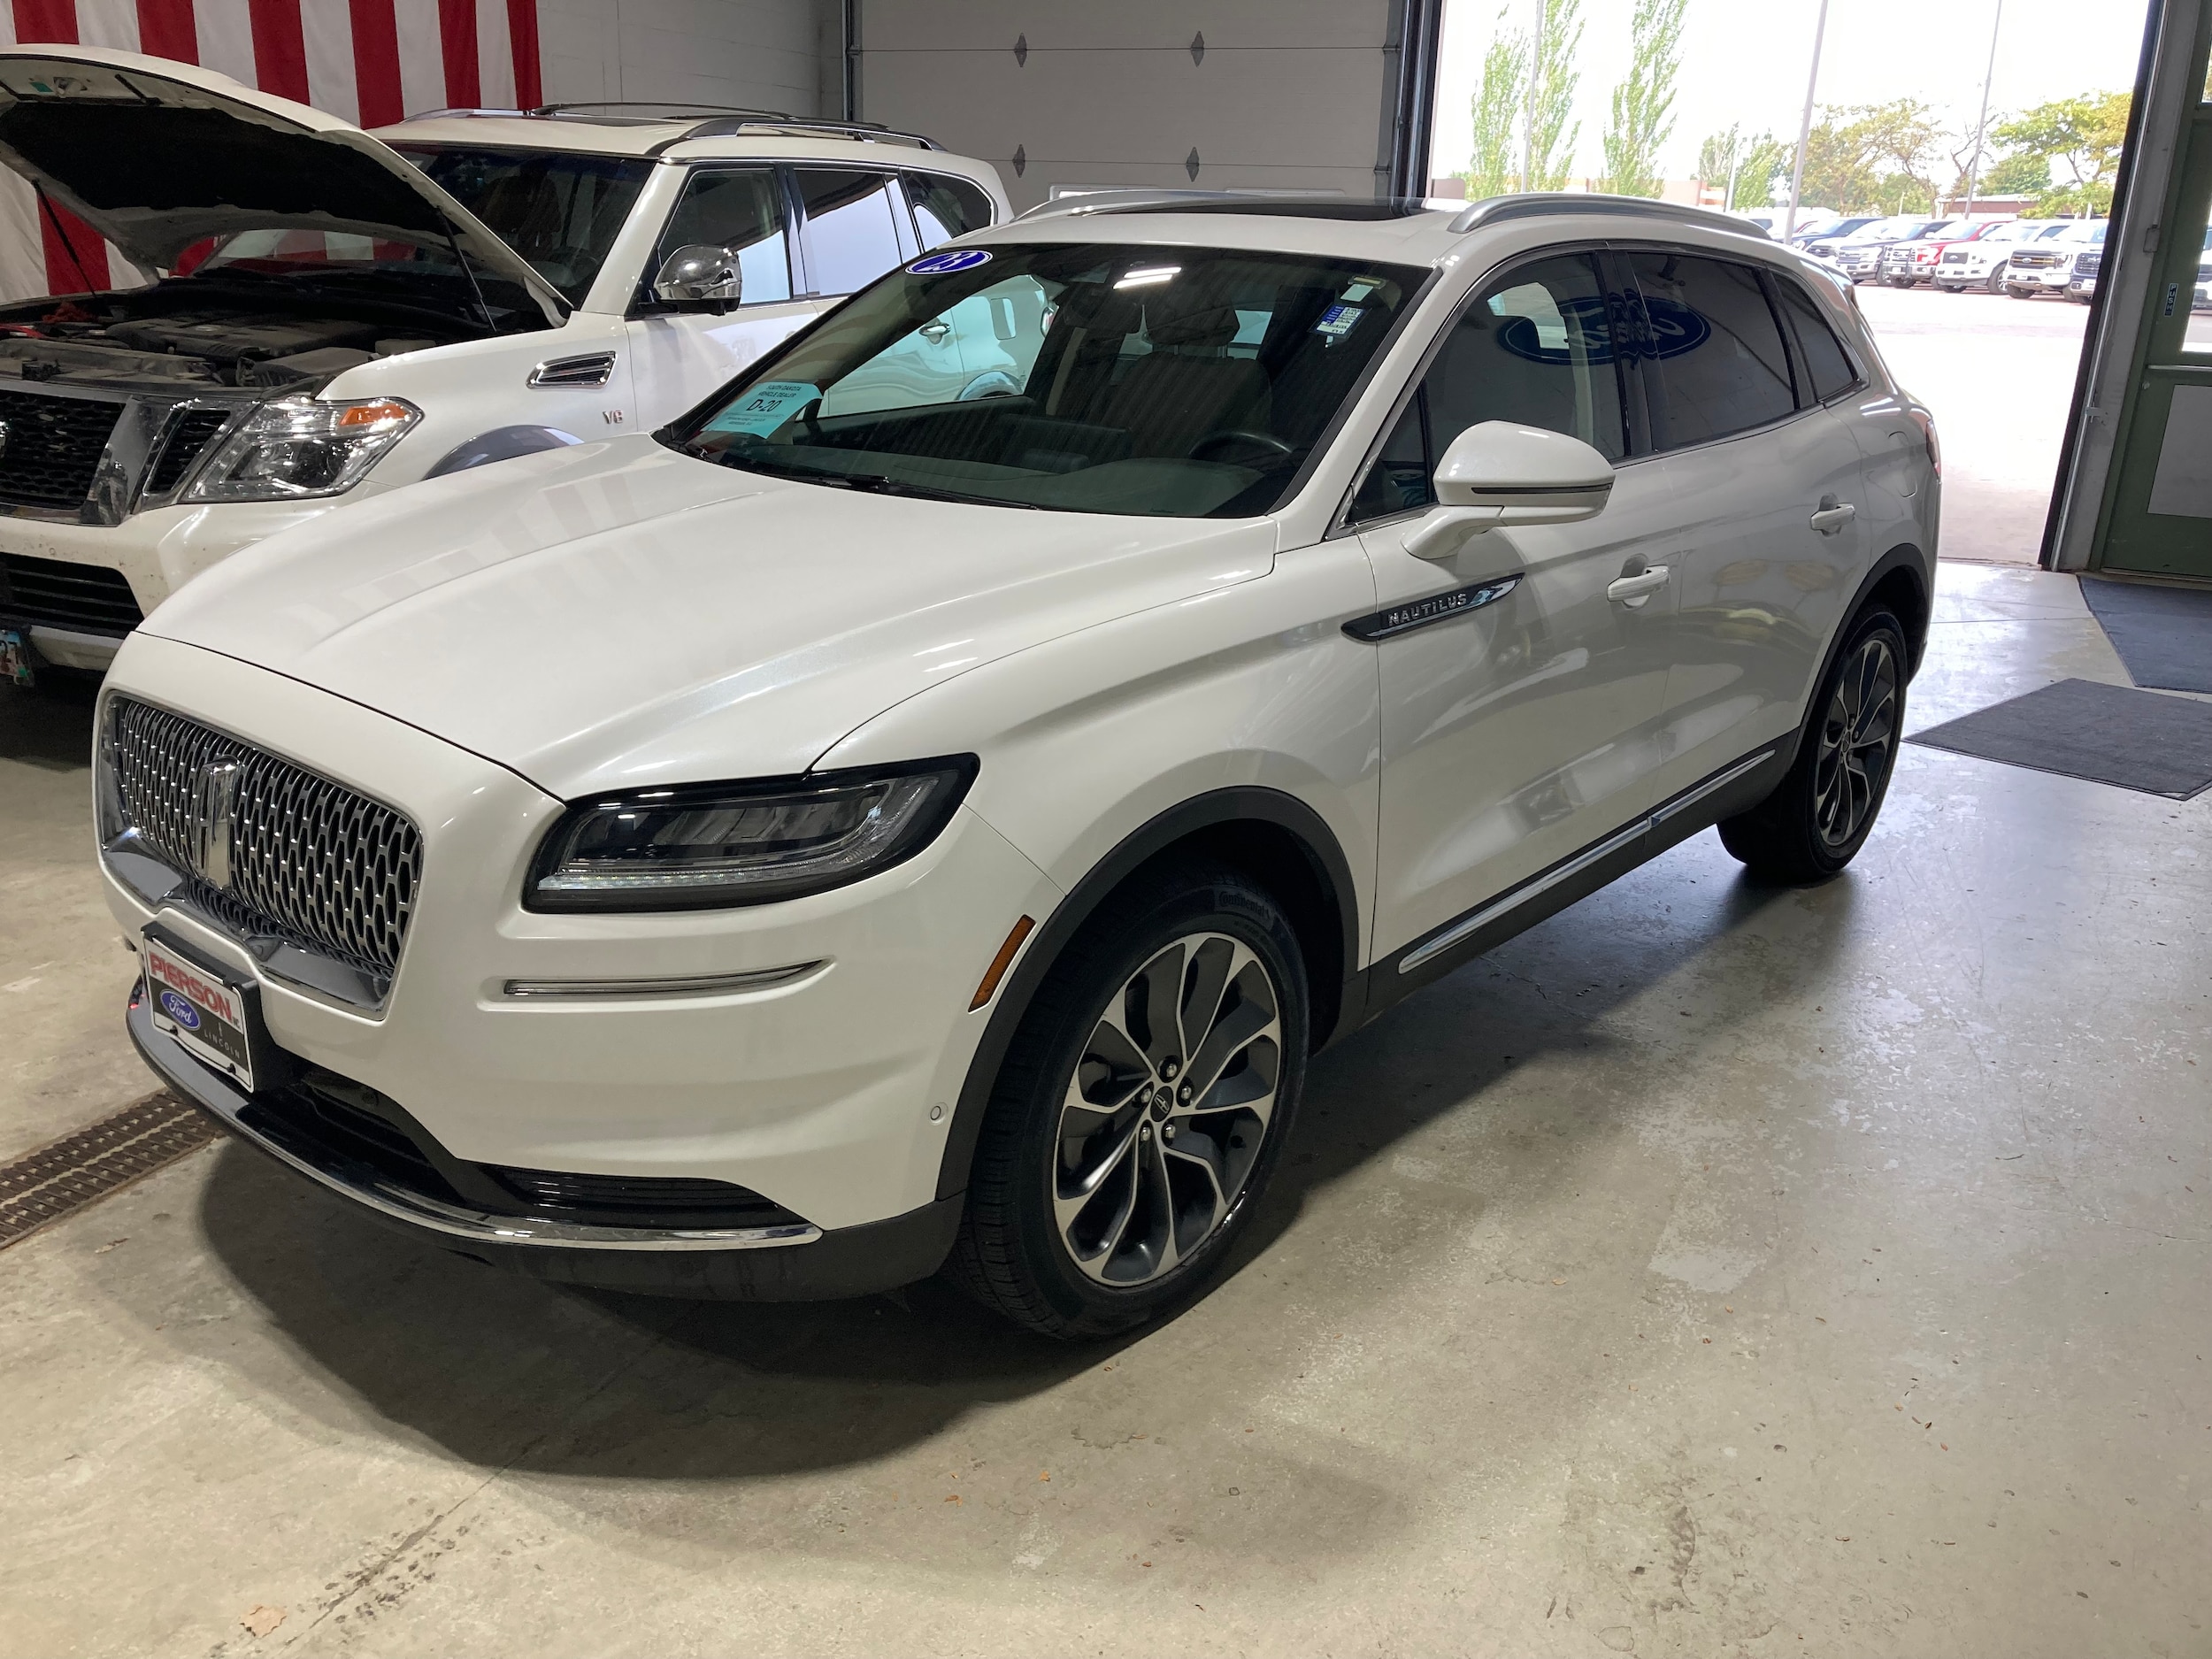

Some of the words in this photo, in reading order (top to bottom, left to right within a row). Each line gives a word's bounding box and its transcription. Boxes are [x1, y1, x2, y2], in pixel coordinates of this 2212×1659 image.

[916, 252, 979, 272] 23
[2166, 284, 2177, 310] PUSH
[746, 399, 783, 412] D-20
[1388, 593, 1467, 626] NAUTILUS
[149, 950, 233, 1024] PIERSON
[169, 994, 193, 1025] Ford
[204, 1029, 241, 1060] LINCOLN
